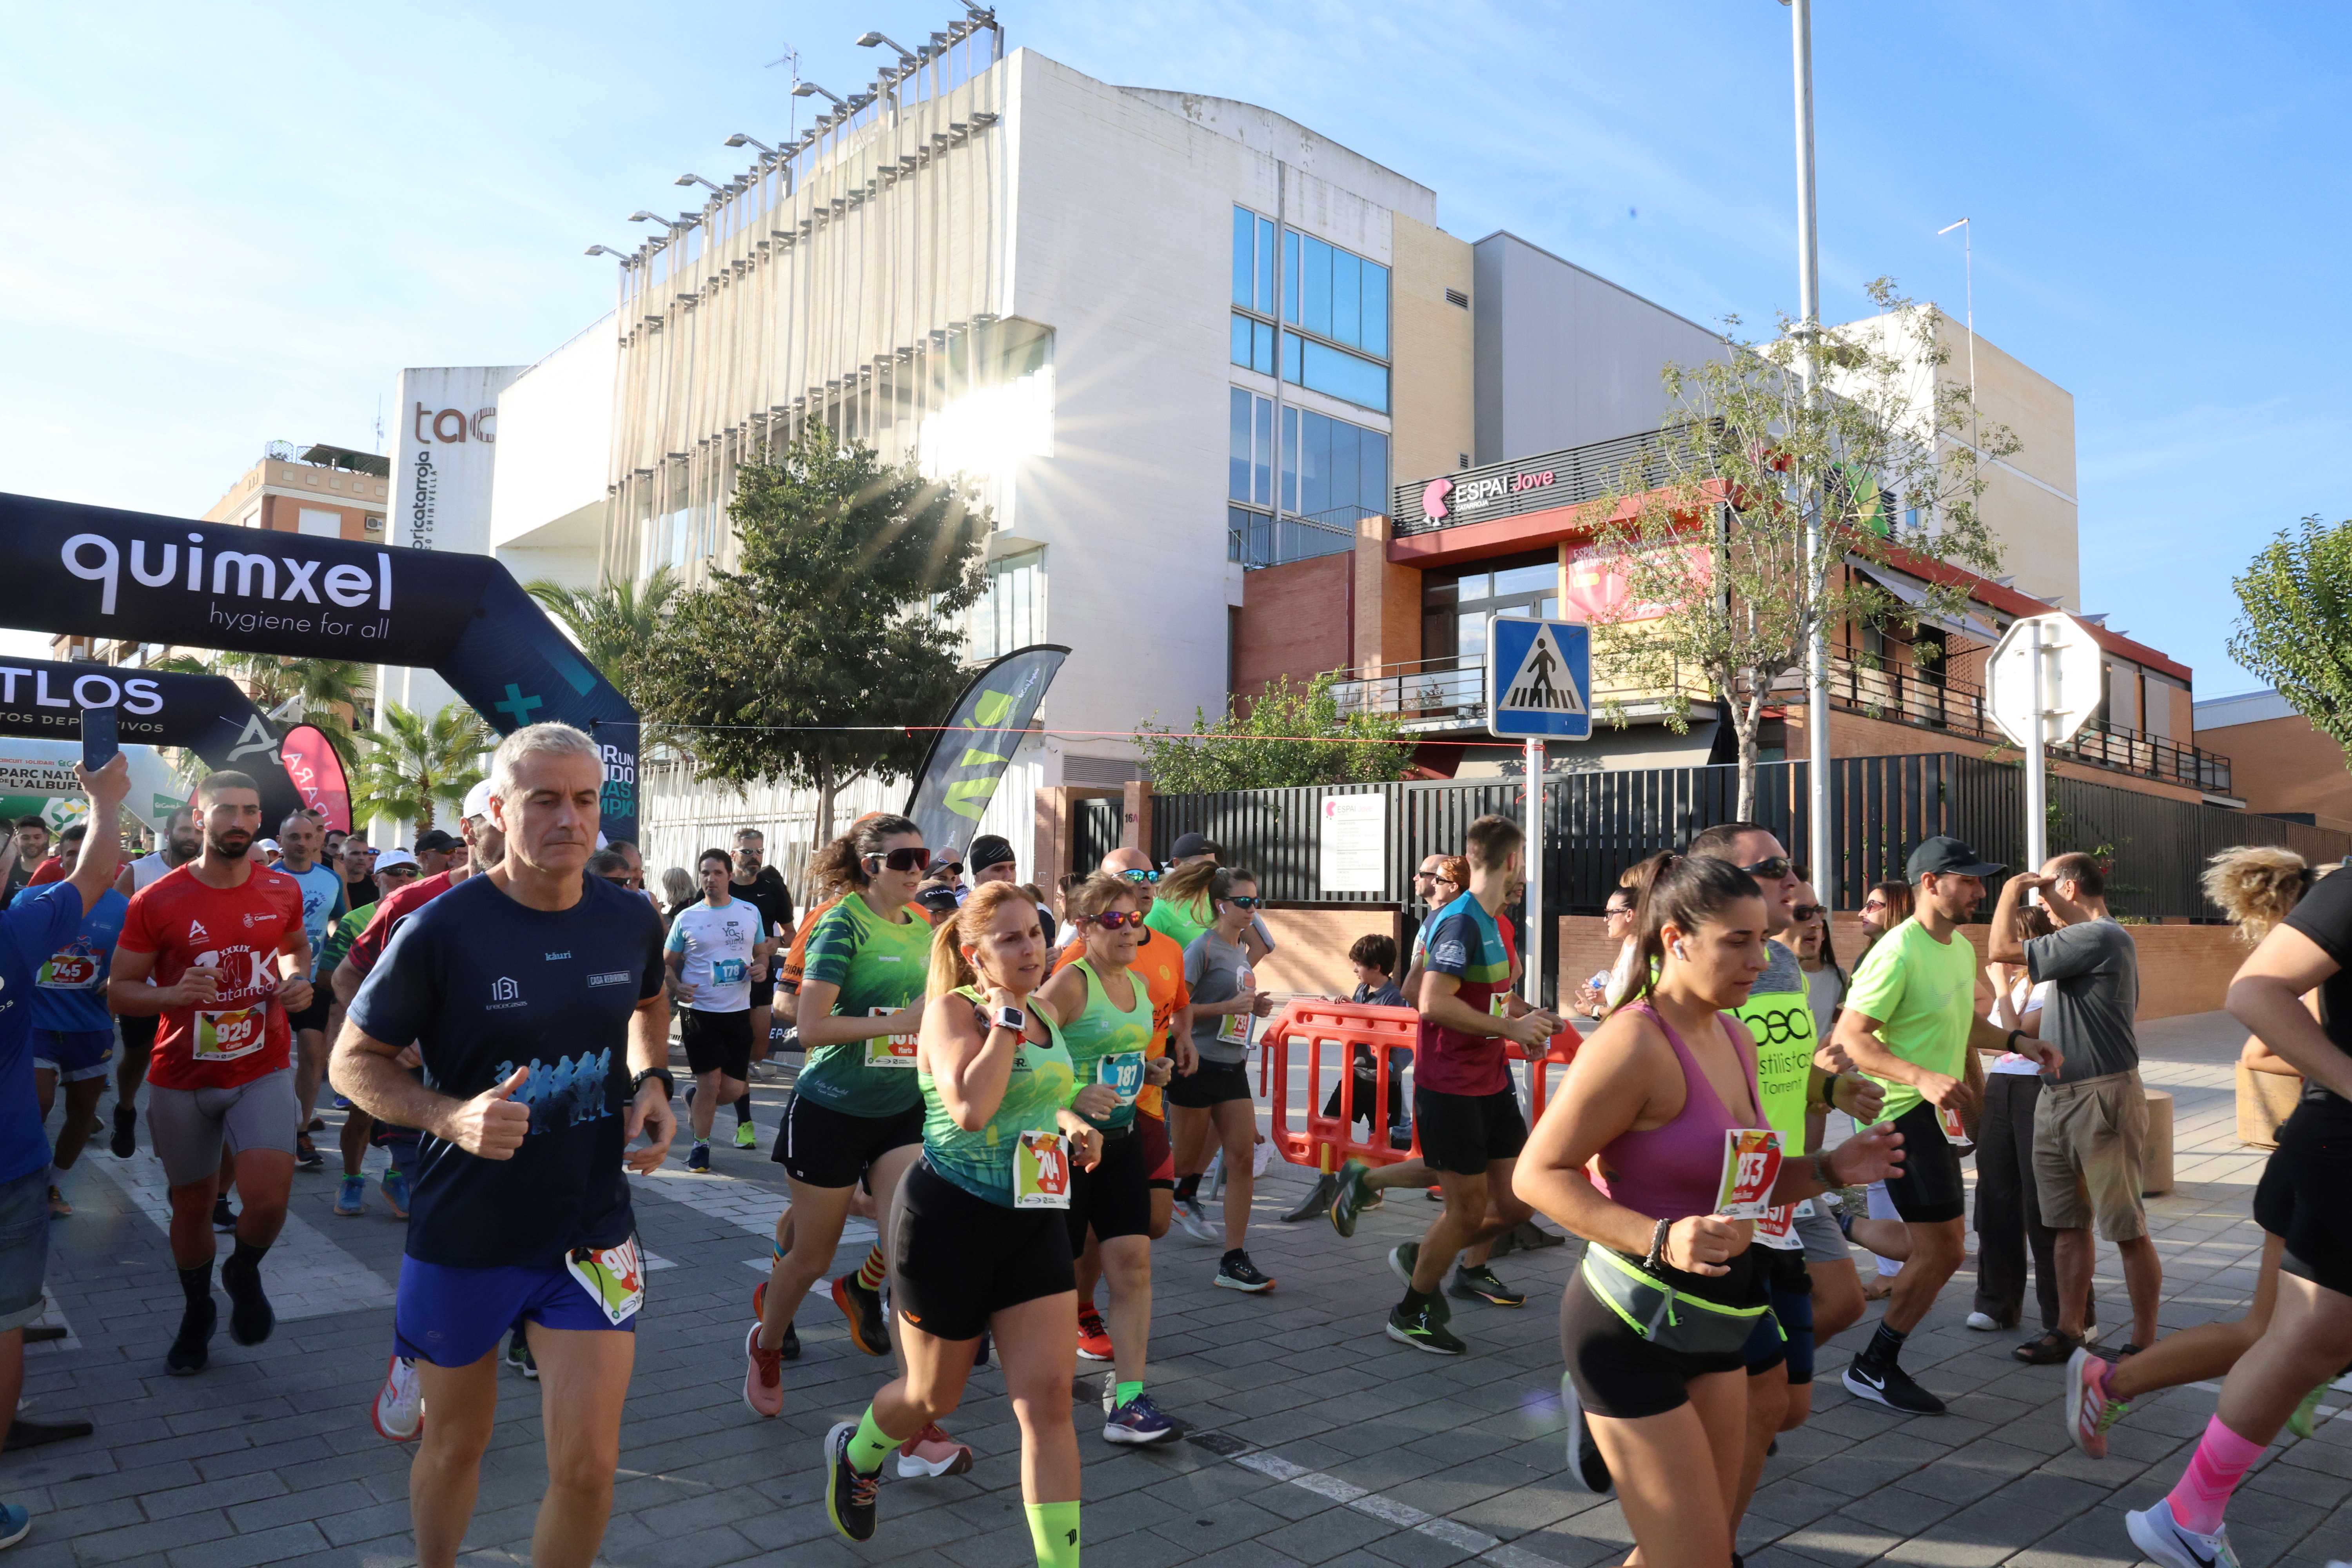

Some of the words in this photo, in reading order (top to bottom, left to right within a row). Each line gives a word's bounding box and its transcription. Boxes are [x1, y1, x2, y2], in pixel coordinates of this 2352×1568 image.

[1455, 476, 1508, 503] ESPAI
[1513, 471, 1554, 491] Jove
[1455, 500, 1488, 511] CATARROJA
[61, 533, 391, 615] quimxel
[210, 601, 310, 632] hygiene
[320, 612, 354, 635] for
[361, 618, 389, 639] all
[42, 715, 164, 733] DEPIVOS
[618, 752, 634, 767] UN
[0, 768, 38, 779] PARC
[1125, 813, 1138, 823] 16A
[220, 945, 250, 957] XXXIX
[52, 962, 82, 977] 745
[722, 965, 740, 977] 178
[216, 1019, 251, 1043] 929
[1117, 1065, 1137, 1087] 187
[1762, 1077, 1802, 1094] Torrent
[1035, 1149, 1060, 1181] 704
